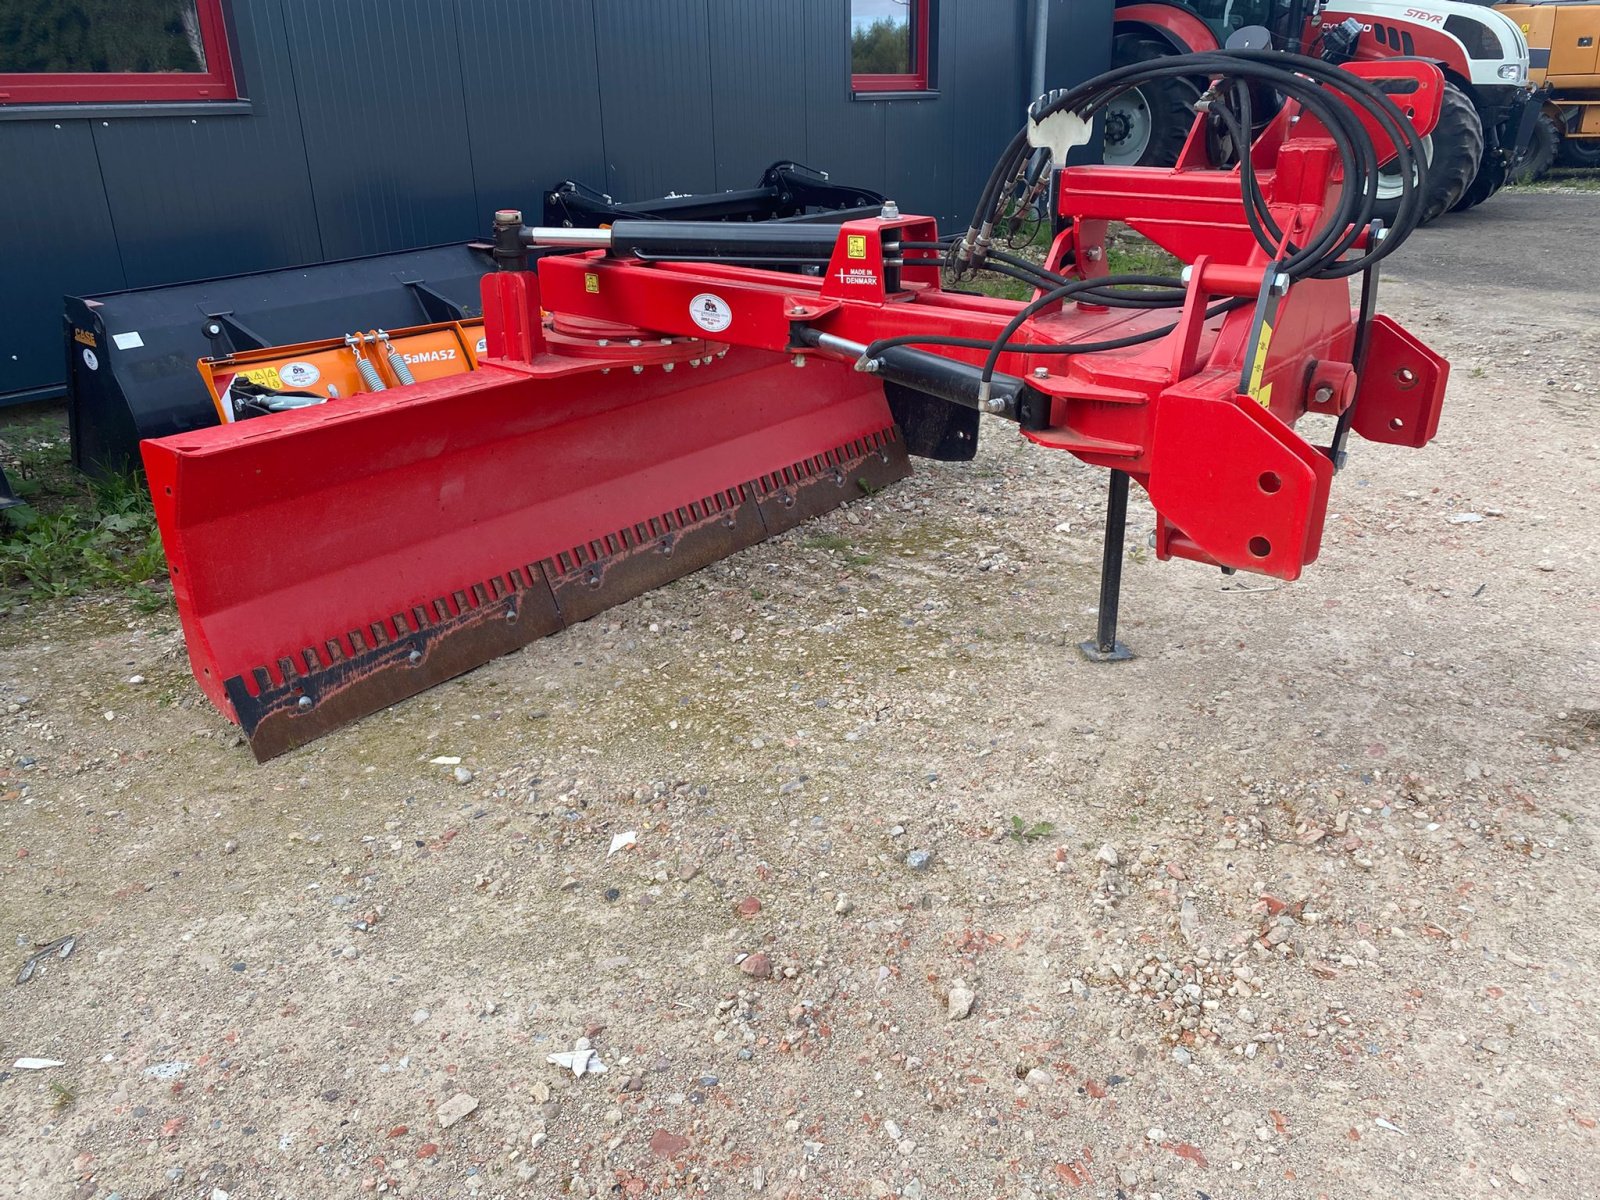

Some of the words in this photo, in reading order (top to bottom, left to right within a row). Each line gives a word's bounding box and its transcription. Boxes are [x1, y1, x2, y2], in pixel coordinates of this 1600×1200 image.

[1403, 8, 1443, 24] STEYR
[846, 277, 877, 285] DENMARK
[74, 327, 95, 342] CASE
[403, 349, 456, 364] SaMASZ
